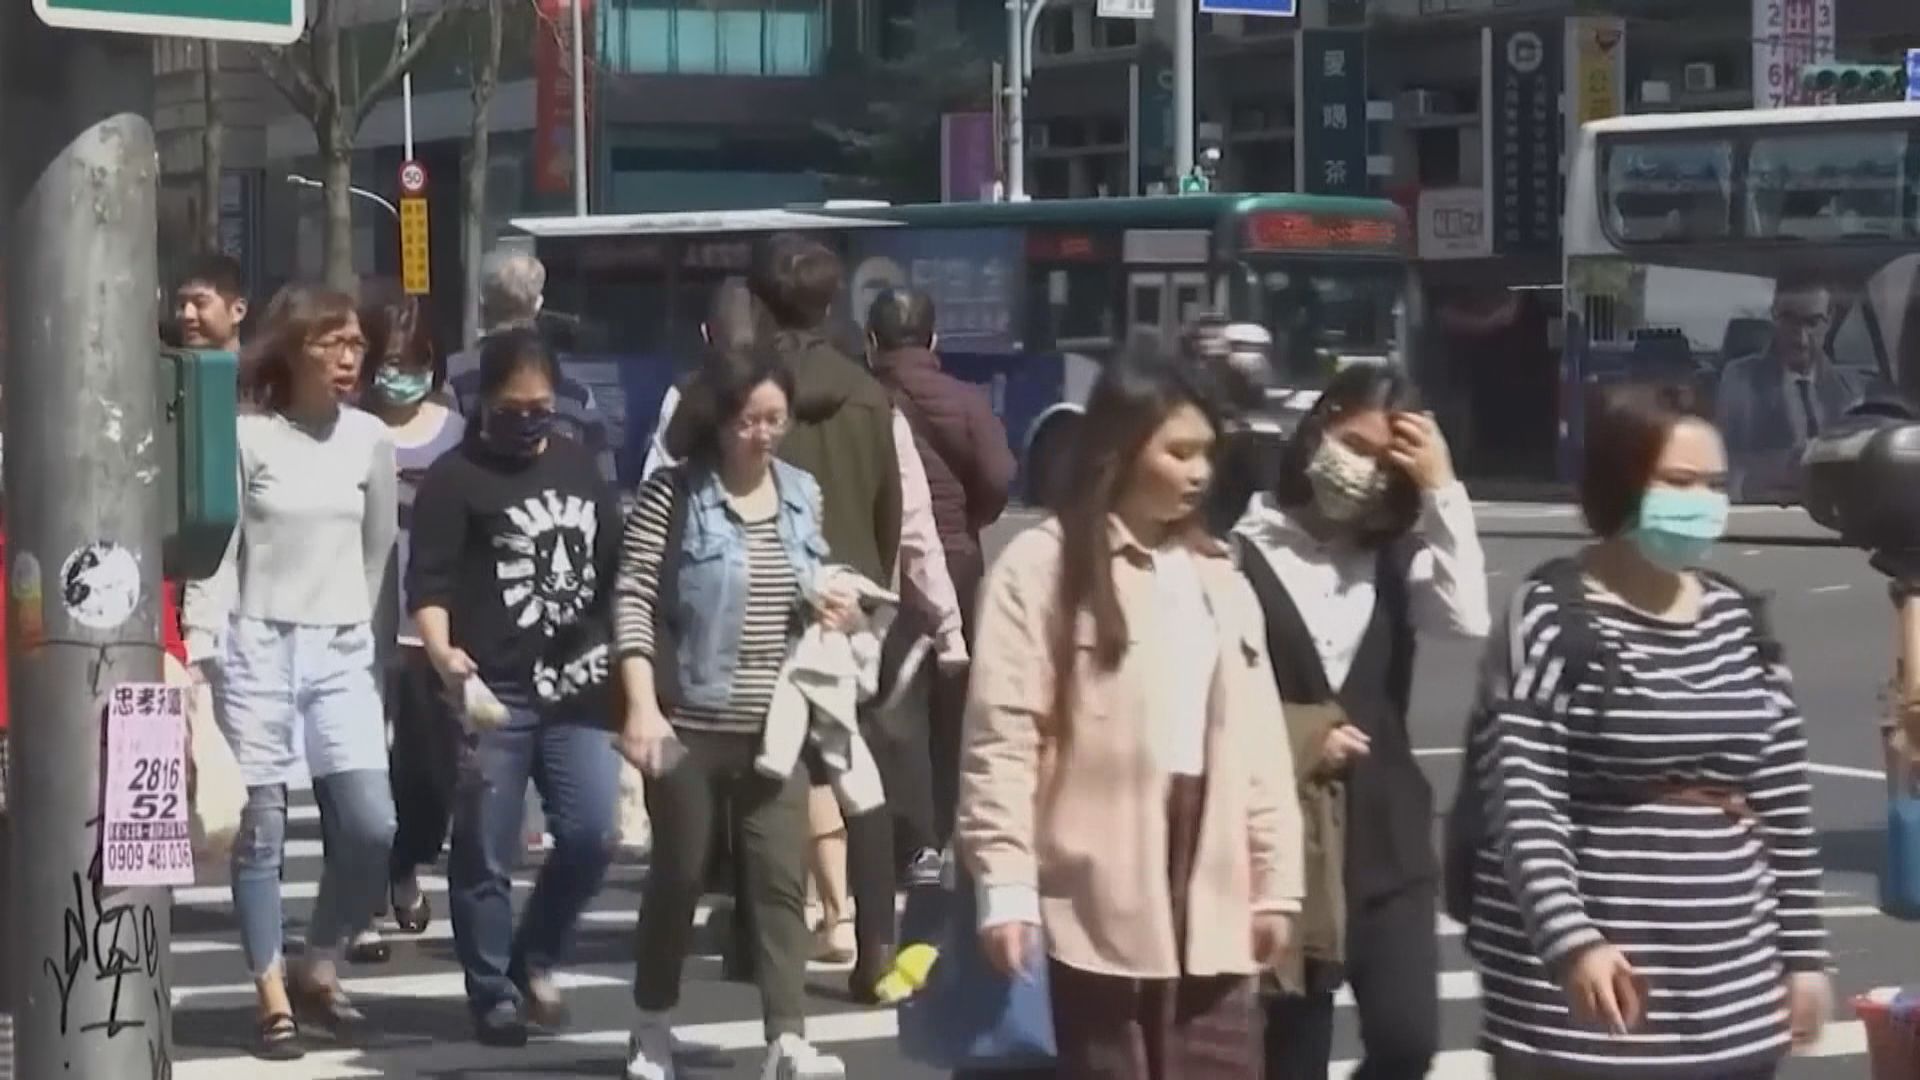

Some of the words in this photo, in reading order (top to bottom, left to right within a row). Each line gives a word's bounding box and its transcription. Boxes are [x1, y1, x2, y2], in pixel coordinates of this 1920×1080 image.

[404, 171, 421, 185] 50
[128, 757, 181, 791] 2816
[130, 793, 179, 819] 52
[108, 843, 144, 871] 0909
